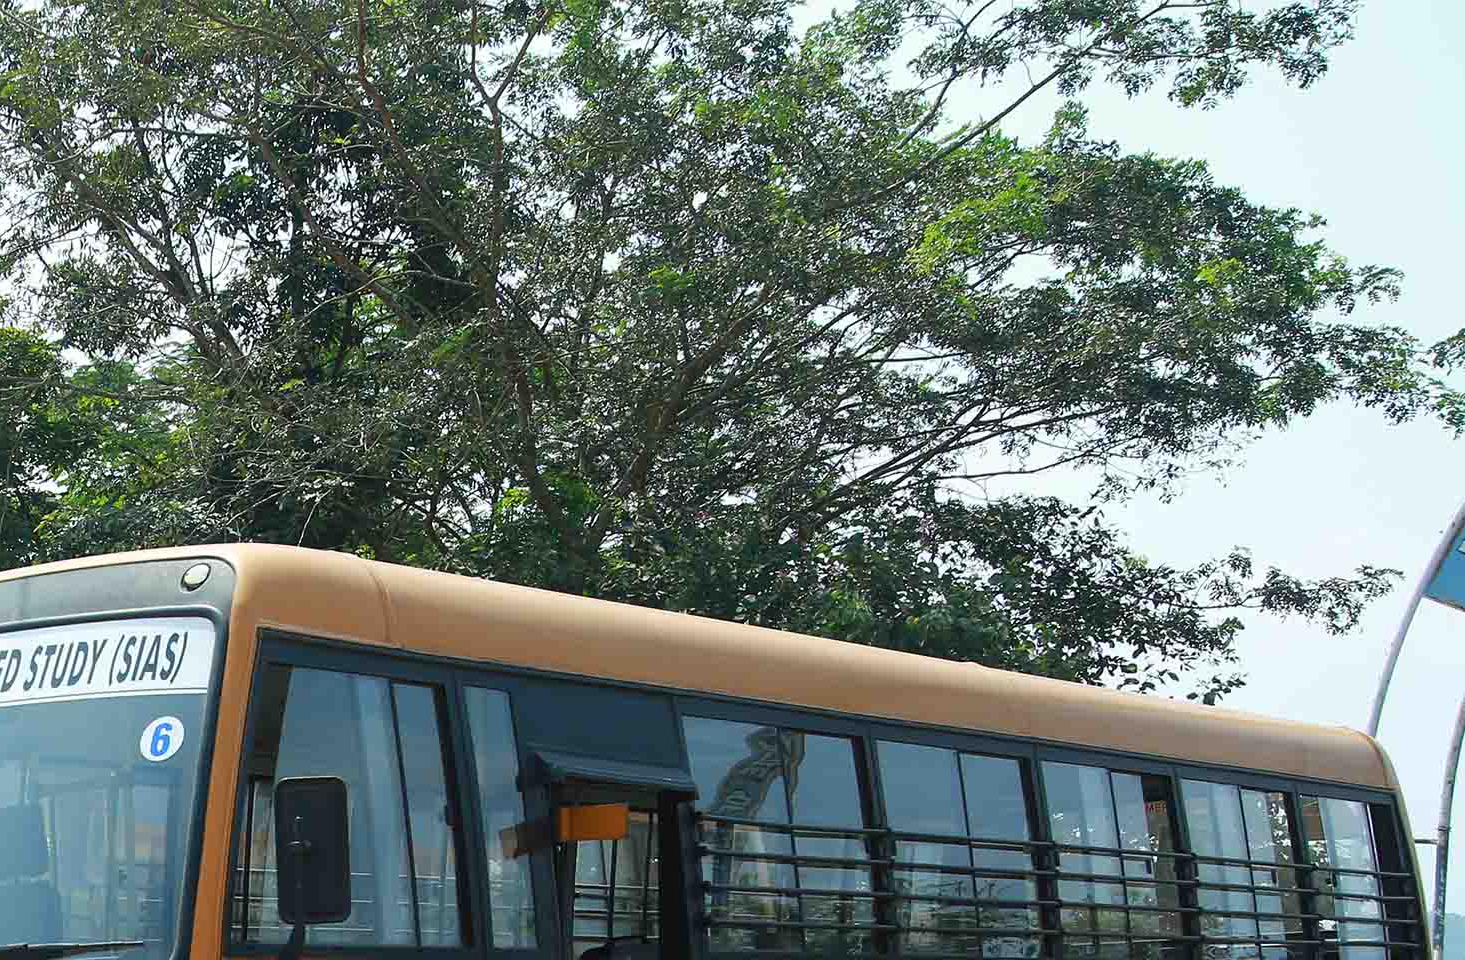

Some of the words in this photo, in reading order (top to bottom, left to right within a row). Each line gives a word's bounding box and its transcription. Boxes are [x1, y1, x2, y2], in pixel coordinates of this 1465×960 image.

[22, 639, 108, 691] STUDY
[109, 631, 188, 686] (SIAS)
[149, 722, 173, 757] 6
